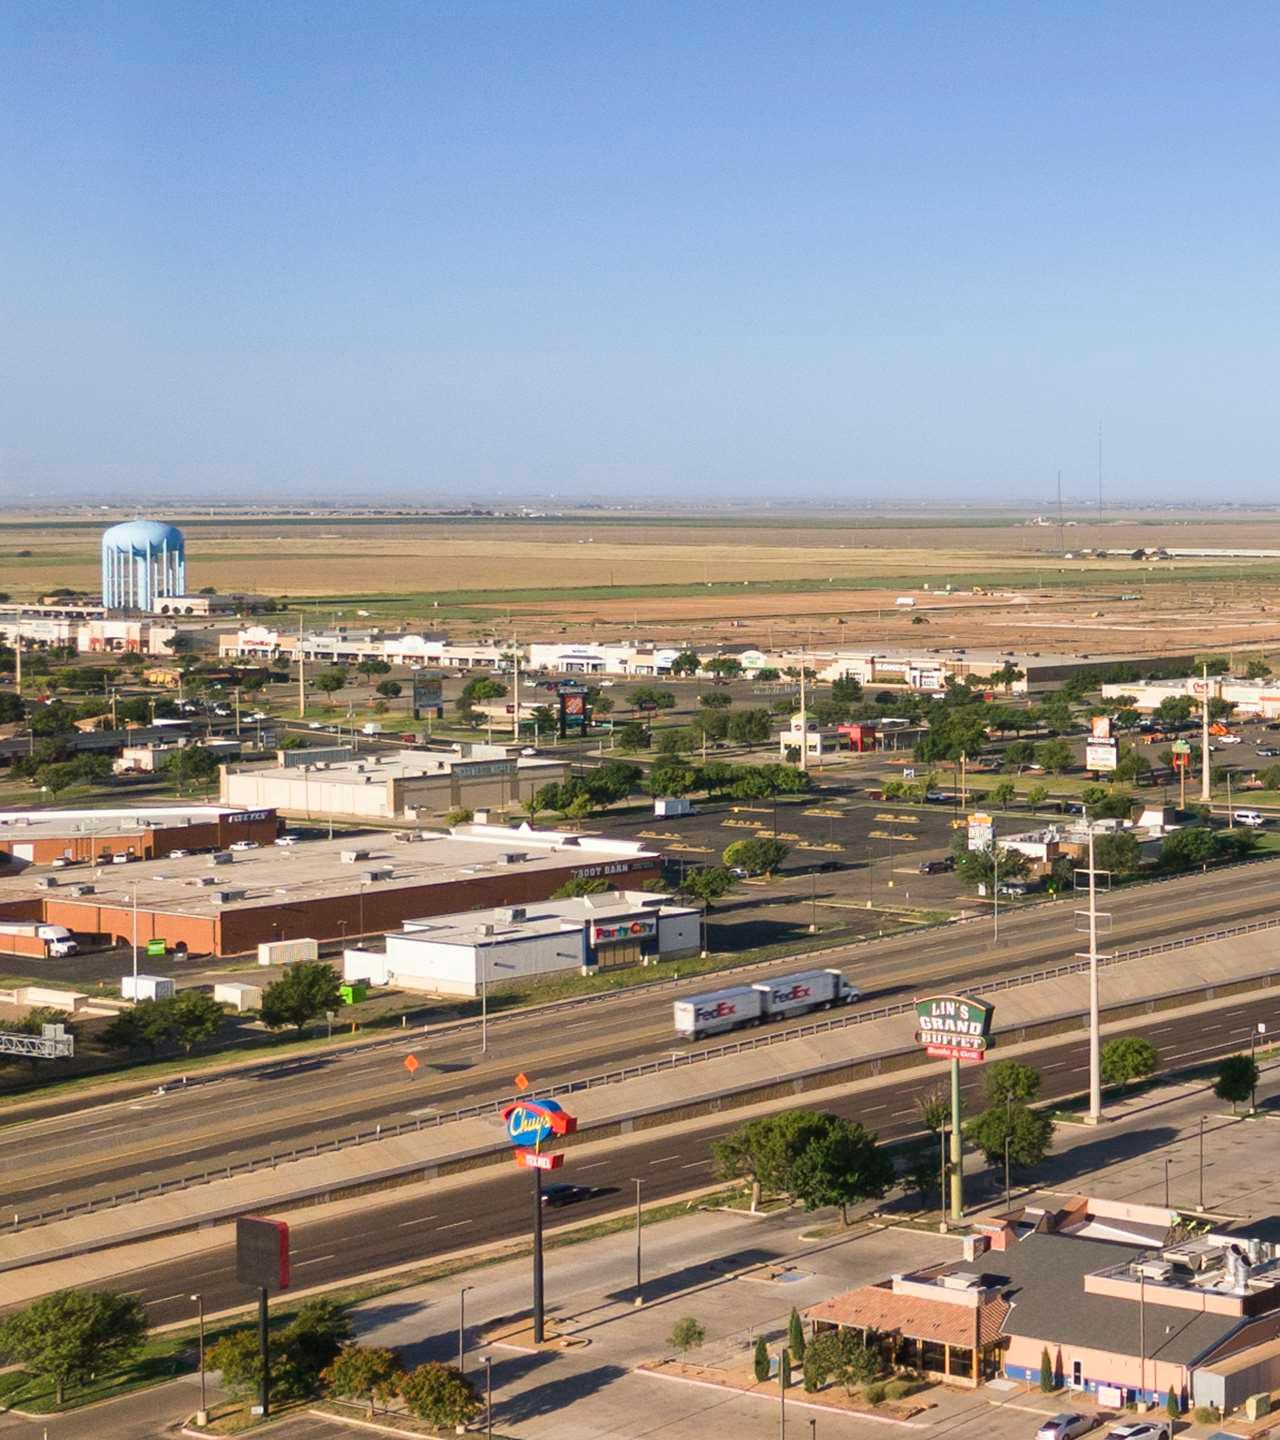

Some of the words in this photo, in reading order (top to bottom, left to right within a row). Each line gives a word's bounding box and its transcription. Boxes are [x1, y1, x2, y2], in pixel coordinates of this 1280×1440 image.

[577, 867, 602, 878] BOOT
[604, 863, 629, 874] BARN
[596, 926, 628, 940] Party
[629, 921, 655, 935] City
[772, 984, 811, 1003] FedEx
[696, 1002, 737, 1021] FedEx
[931, 1000, 970, 1020] LIN'S
[919, 1015, 983, 1036] GRAND
[920, 1032, 982, 1049] BUFFET
